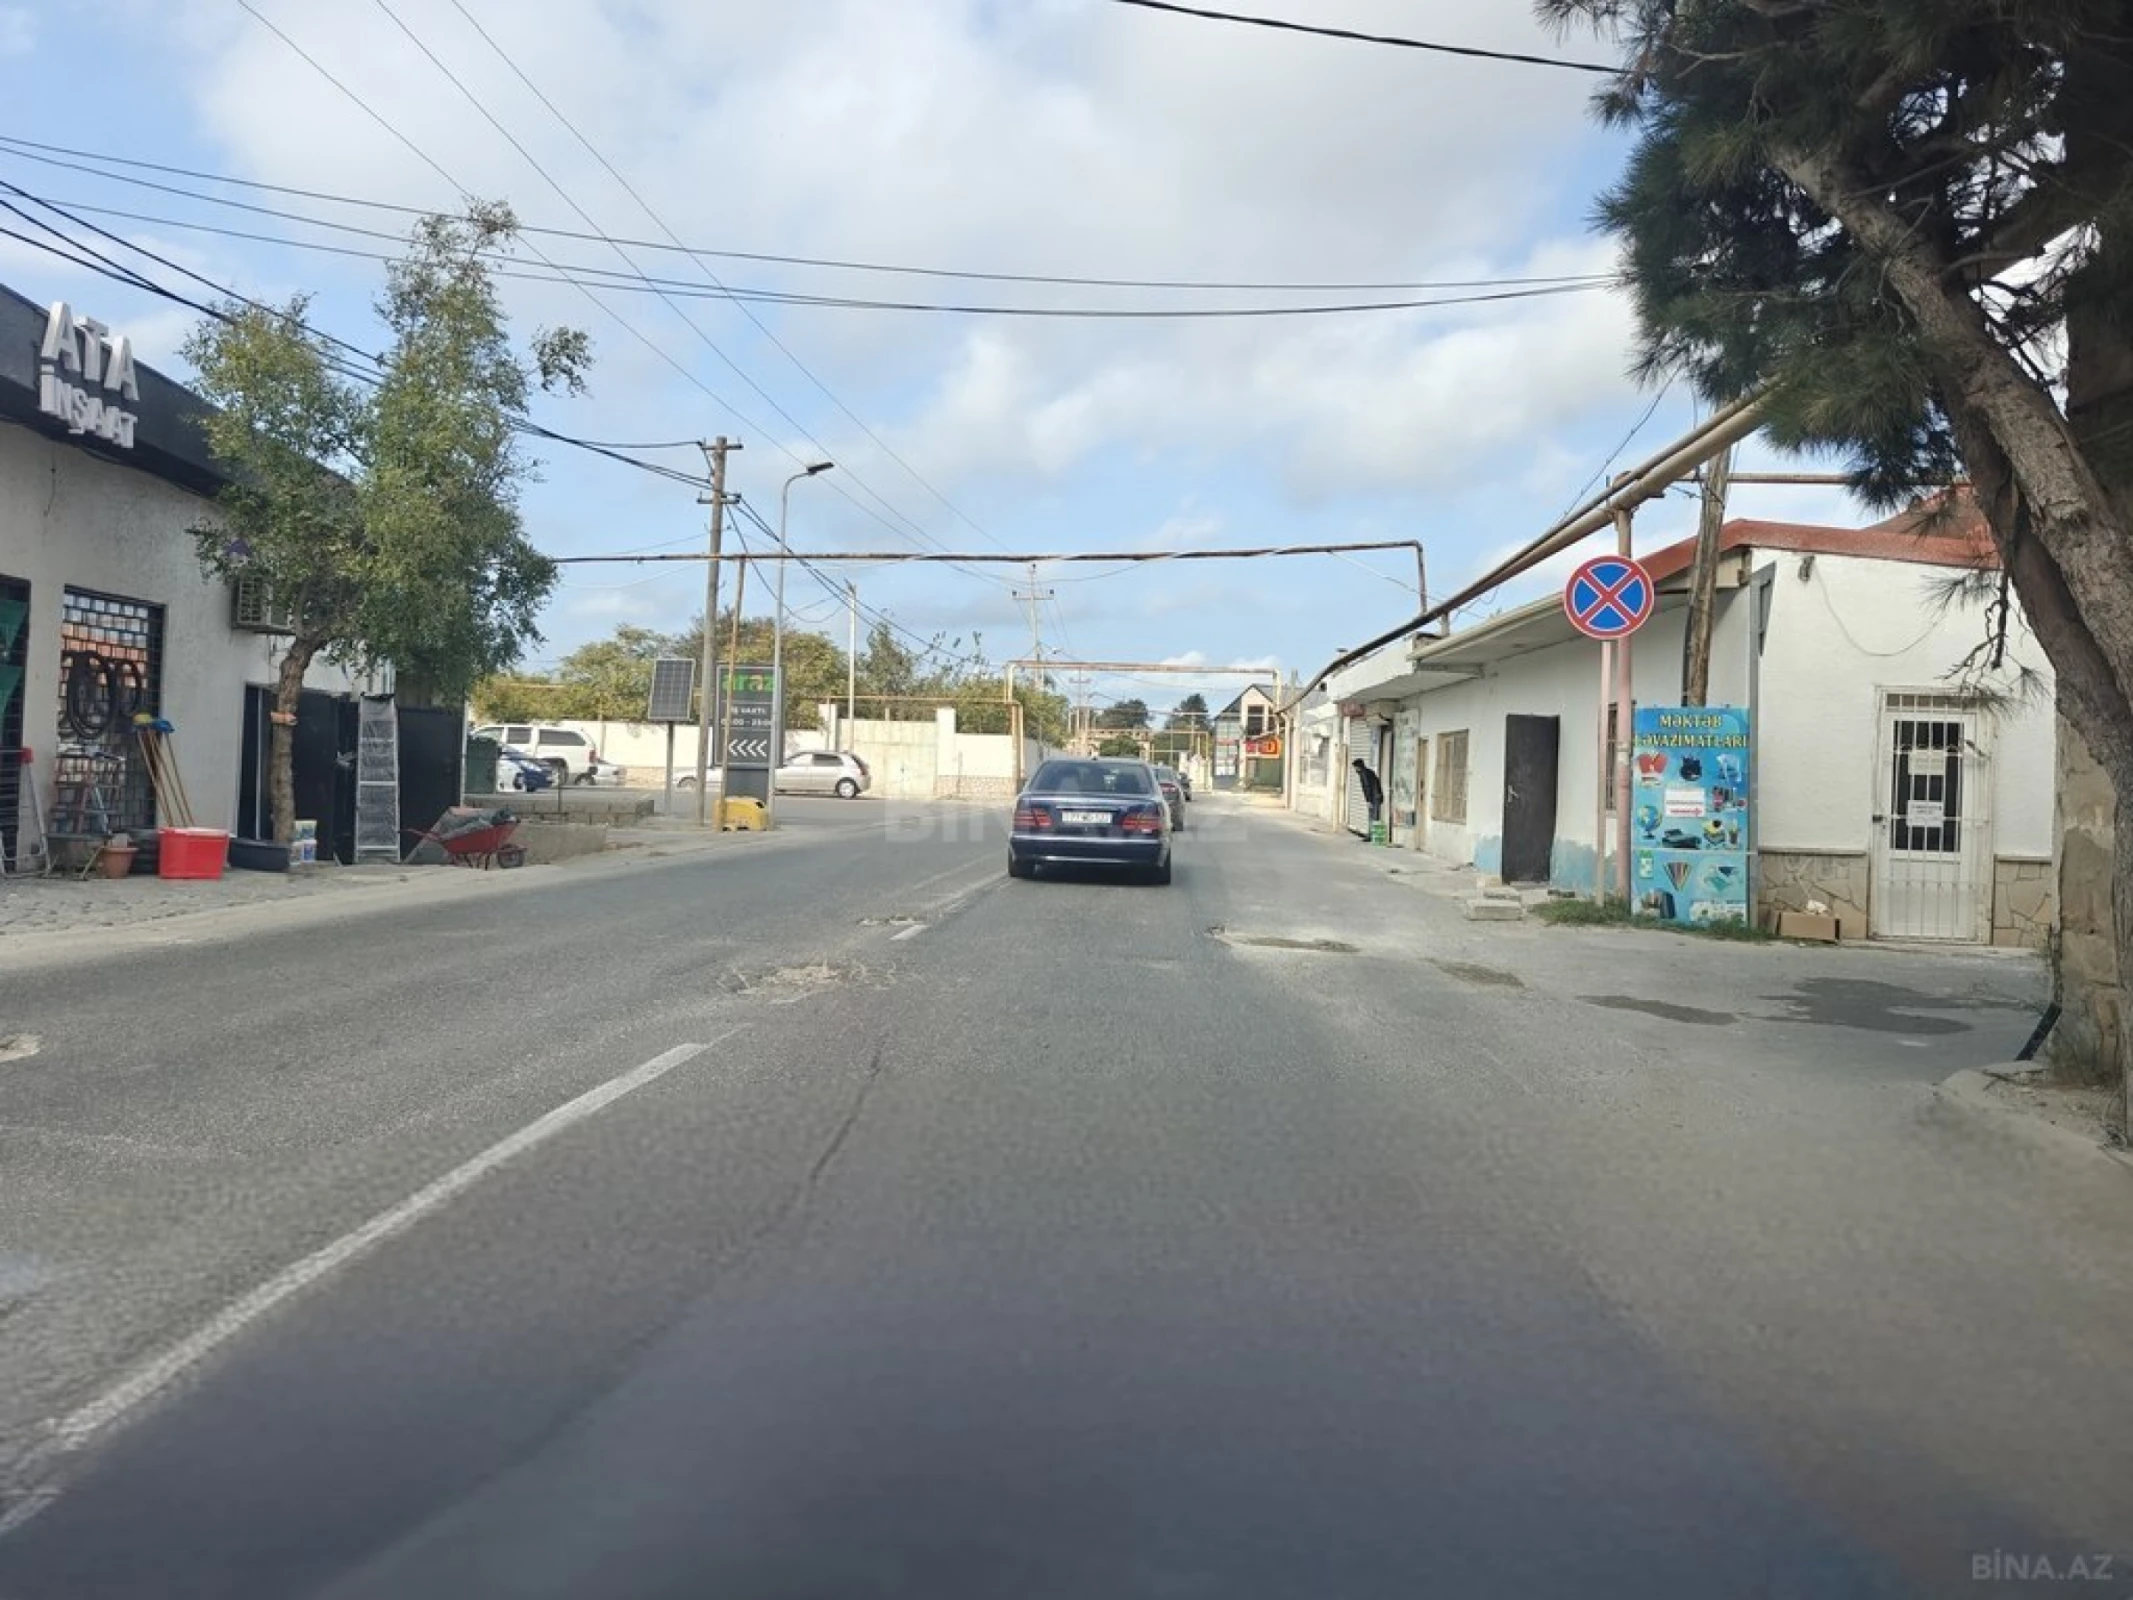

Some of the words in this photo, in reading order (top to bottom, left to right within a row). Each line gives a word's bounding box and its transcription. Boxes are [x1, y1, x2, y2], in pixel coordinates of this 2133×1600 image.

[41, 301, 140, 401] ATA
[40, 364, 138, 448] İNŞAAT
[1660, 714, 1722, 728] MƏKTƏB
